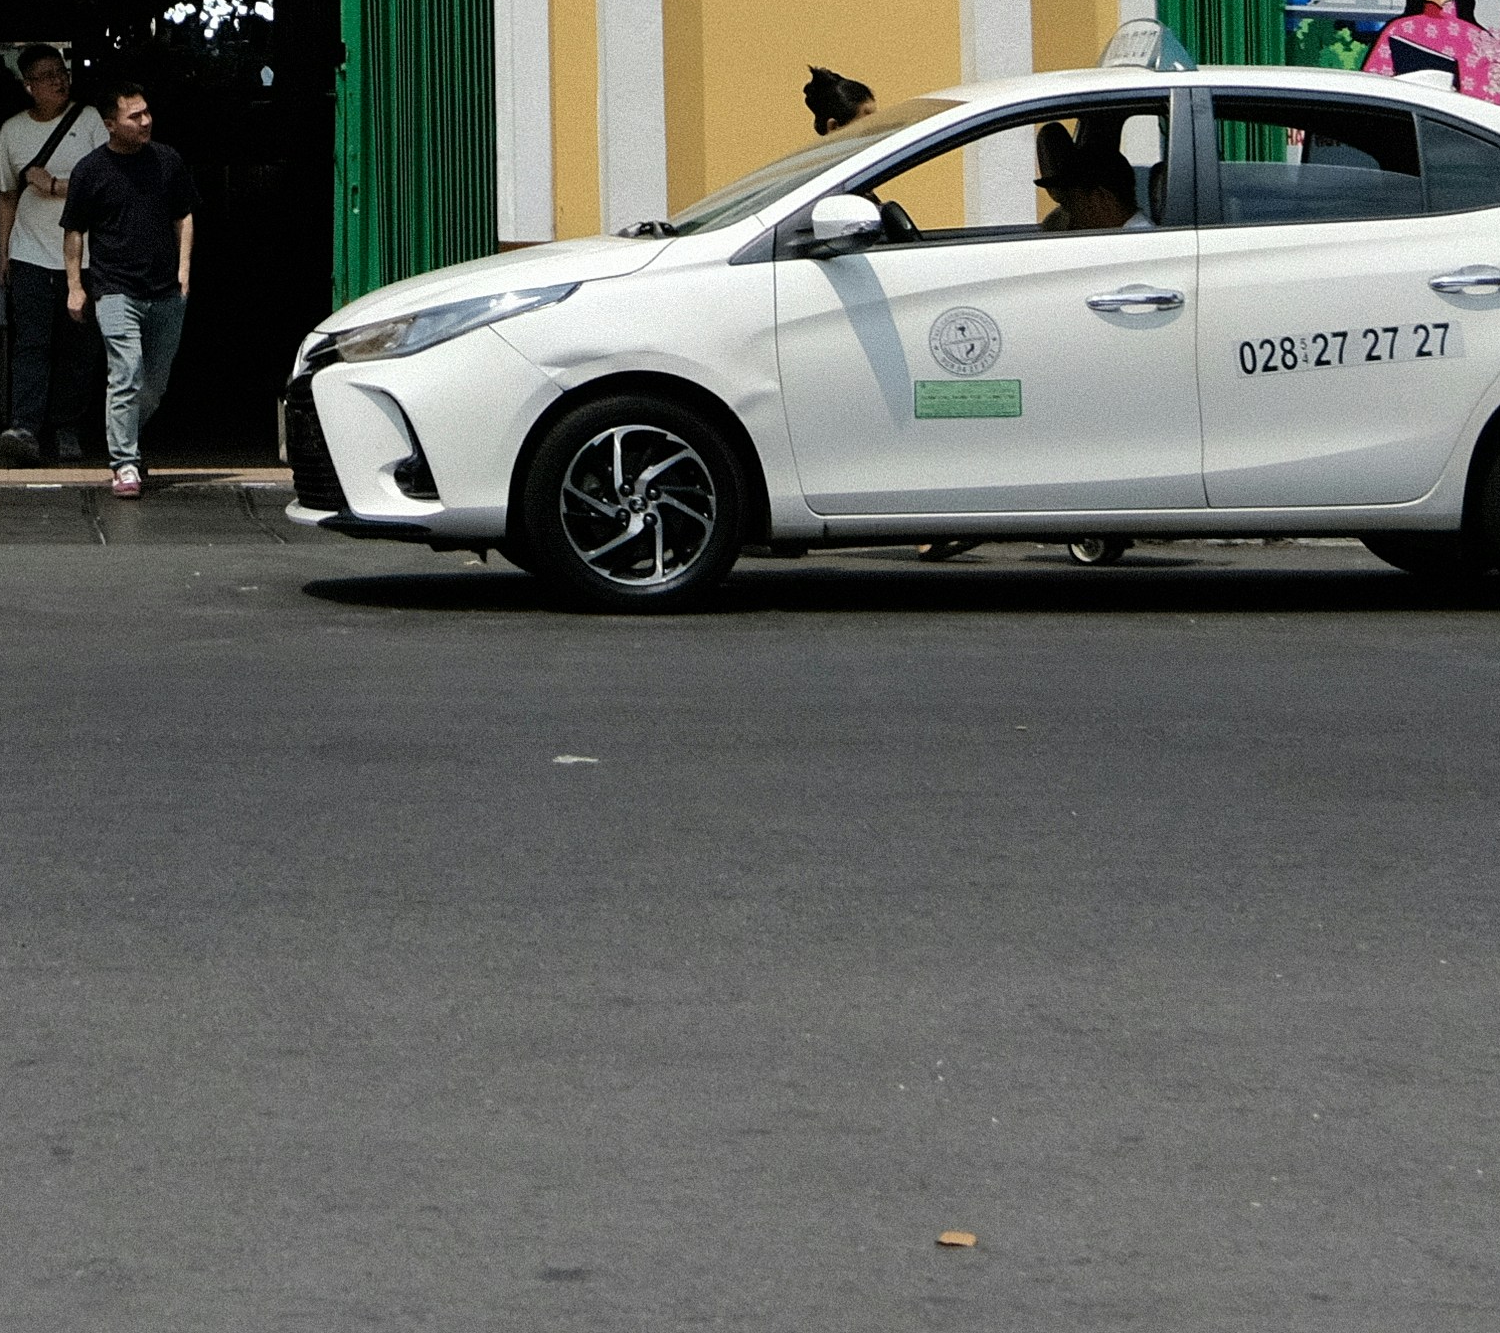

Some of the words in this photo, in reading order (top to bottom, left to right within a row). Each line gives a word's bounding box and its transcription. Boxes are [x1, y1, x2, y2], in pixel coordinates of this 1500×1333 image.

[1238, 335, 1300, 375] 028
[1311, 331, 1349, 367] 27
[1361, 326, 1400, 362] 27
[1412, 322, 1451, 358] 27
